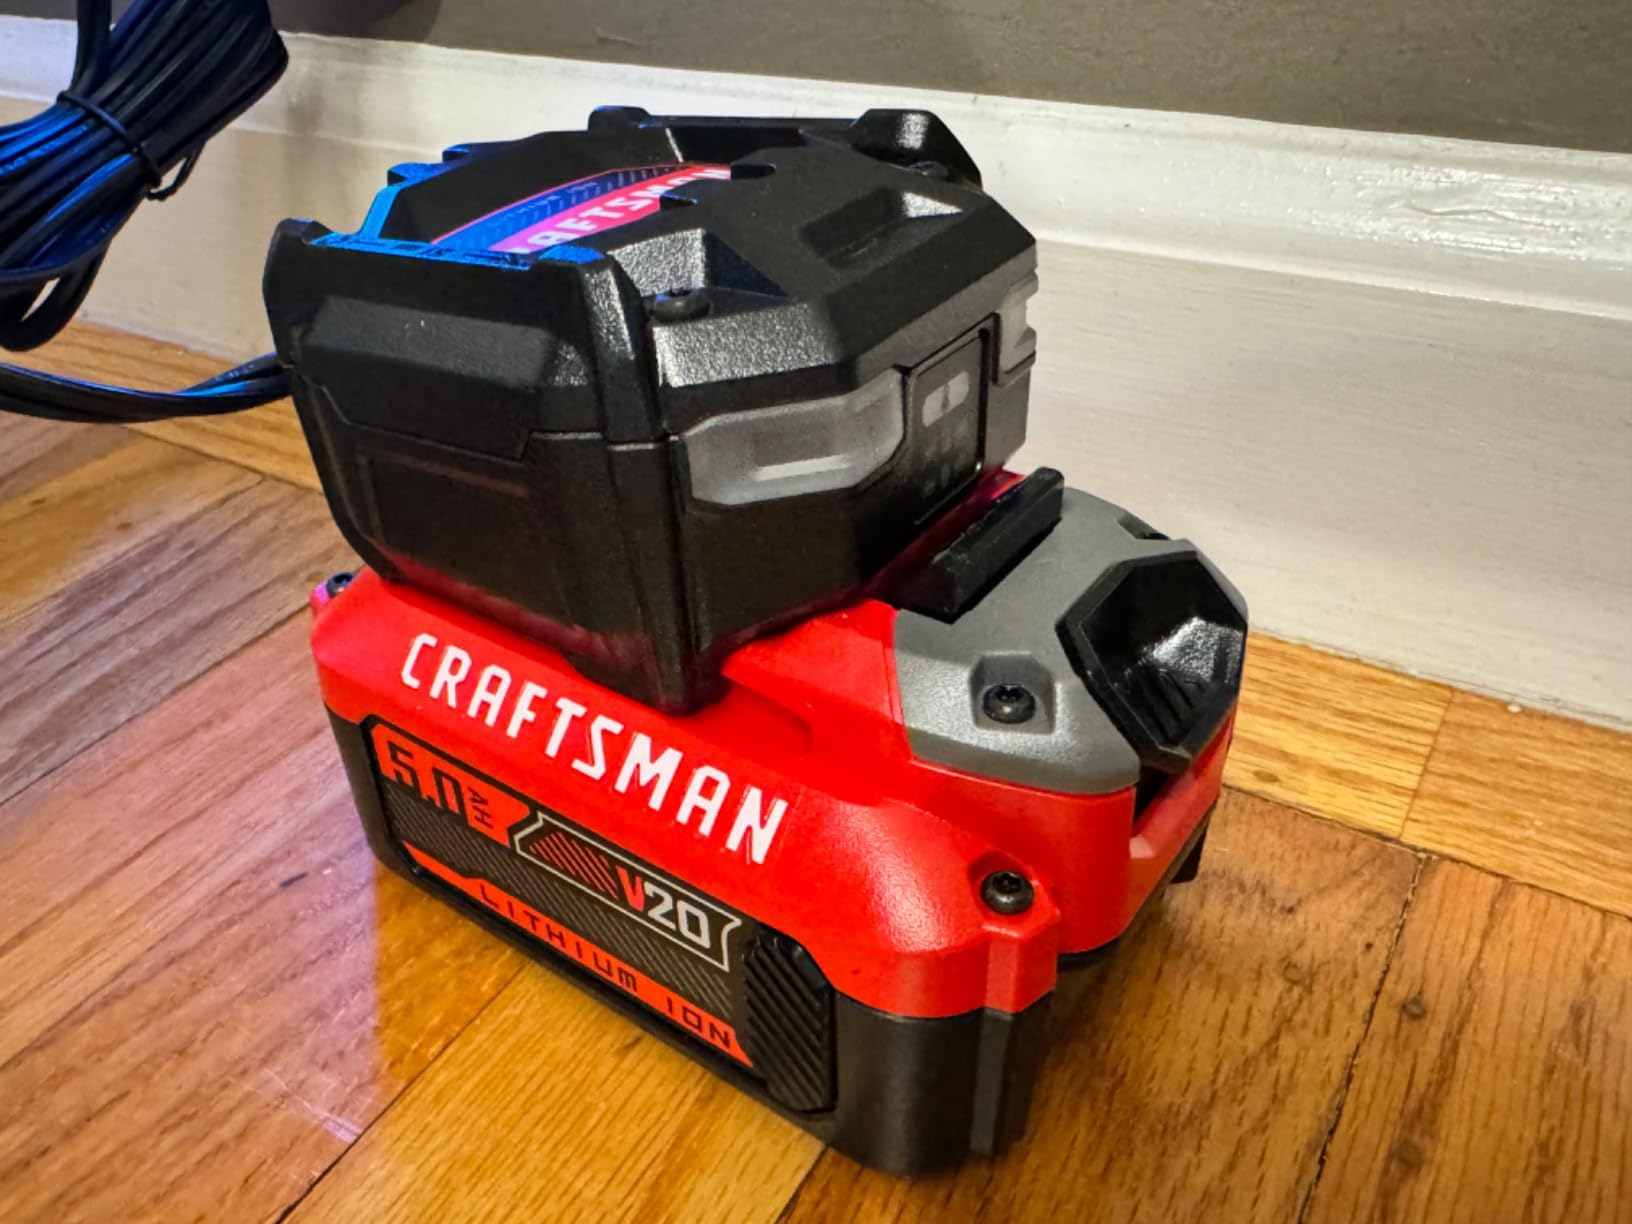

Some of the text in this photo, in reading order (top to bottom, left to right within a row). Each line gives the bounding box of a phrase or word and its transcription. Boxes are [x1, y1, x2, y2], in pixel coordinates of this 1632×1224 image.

[390, 739, 464, 820] 5.0
[400, 633, 788, 865] CRAFTSMAN
[480, 883, 732, 1050] LITHIUM ION
[616, 864, 711, 949] V20
